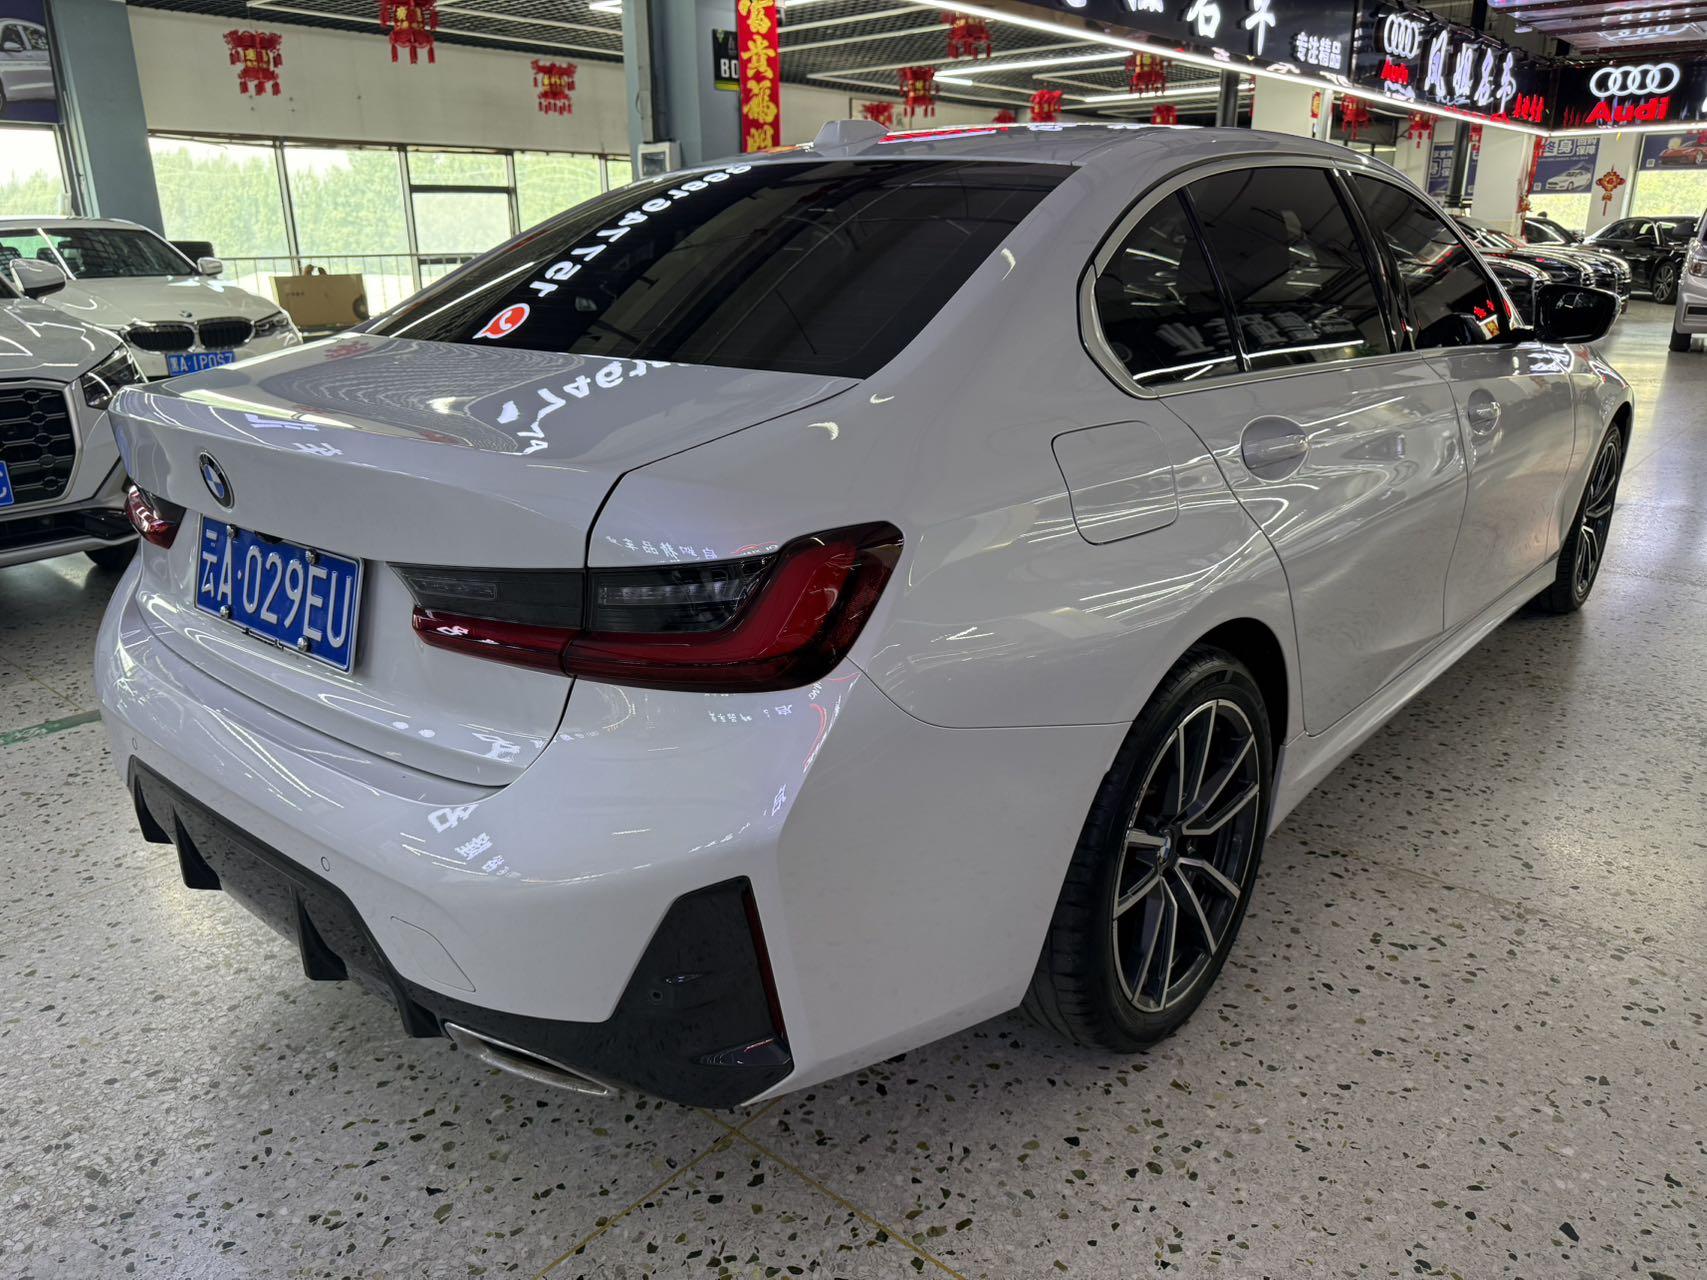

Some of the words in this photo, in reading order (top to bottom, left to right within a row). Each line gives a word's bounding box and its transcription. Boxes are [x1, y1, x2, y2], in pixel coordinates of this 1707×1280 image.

[1296, 31, 1342, 70] 专注精品
[1586, 96, 1671, 123] Audi
